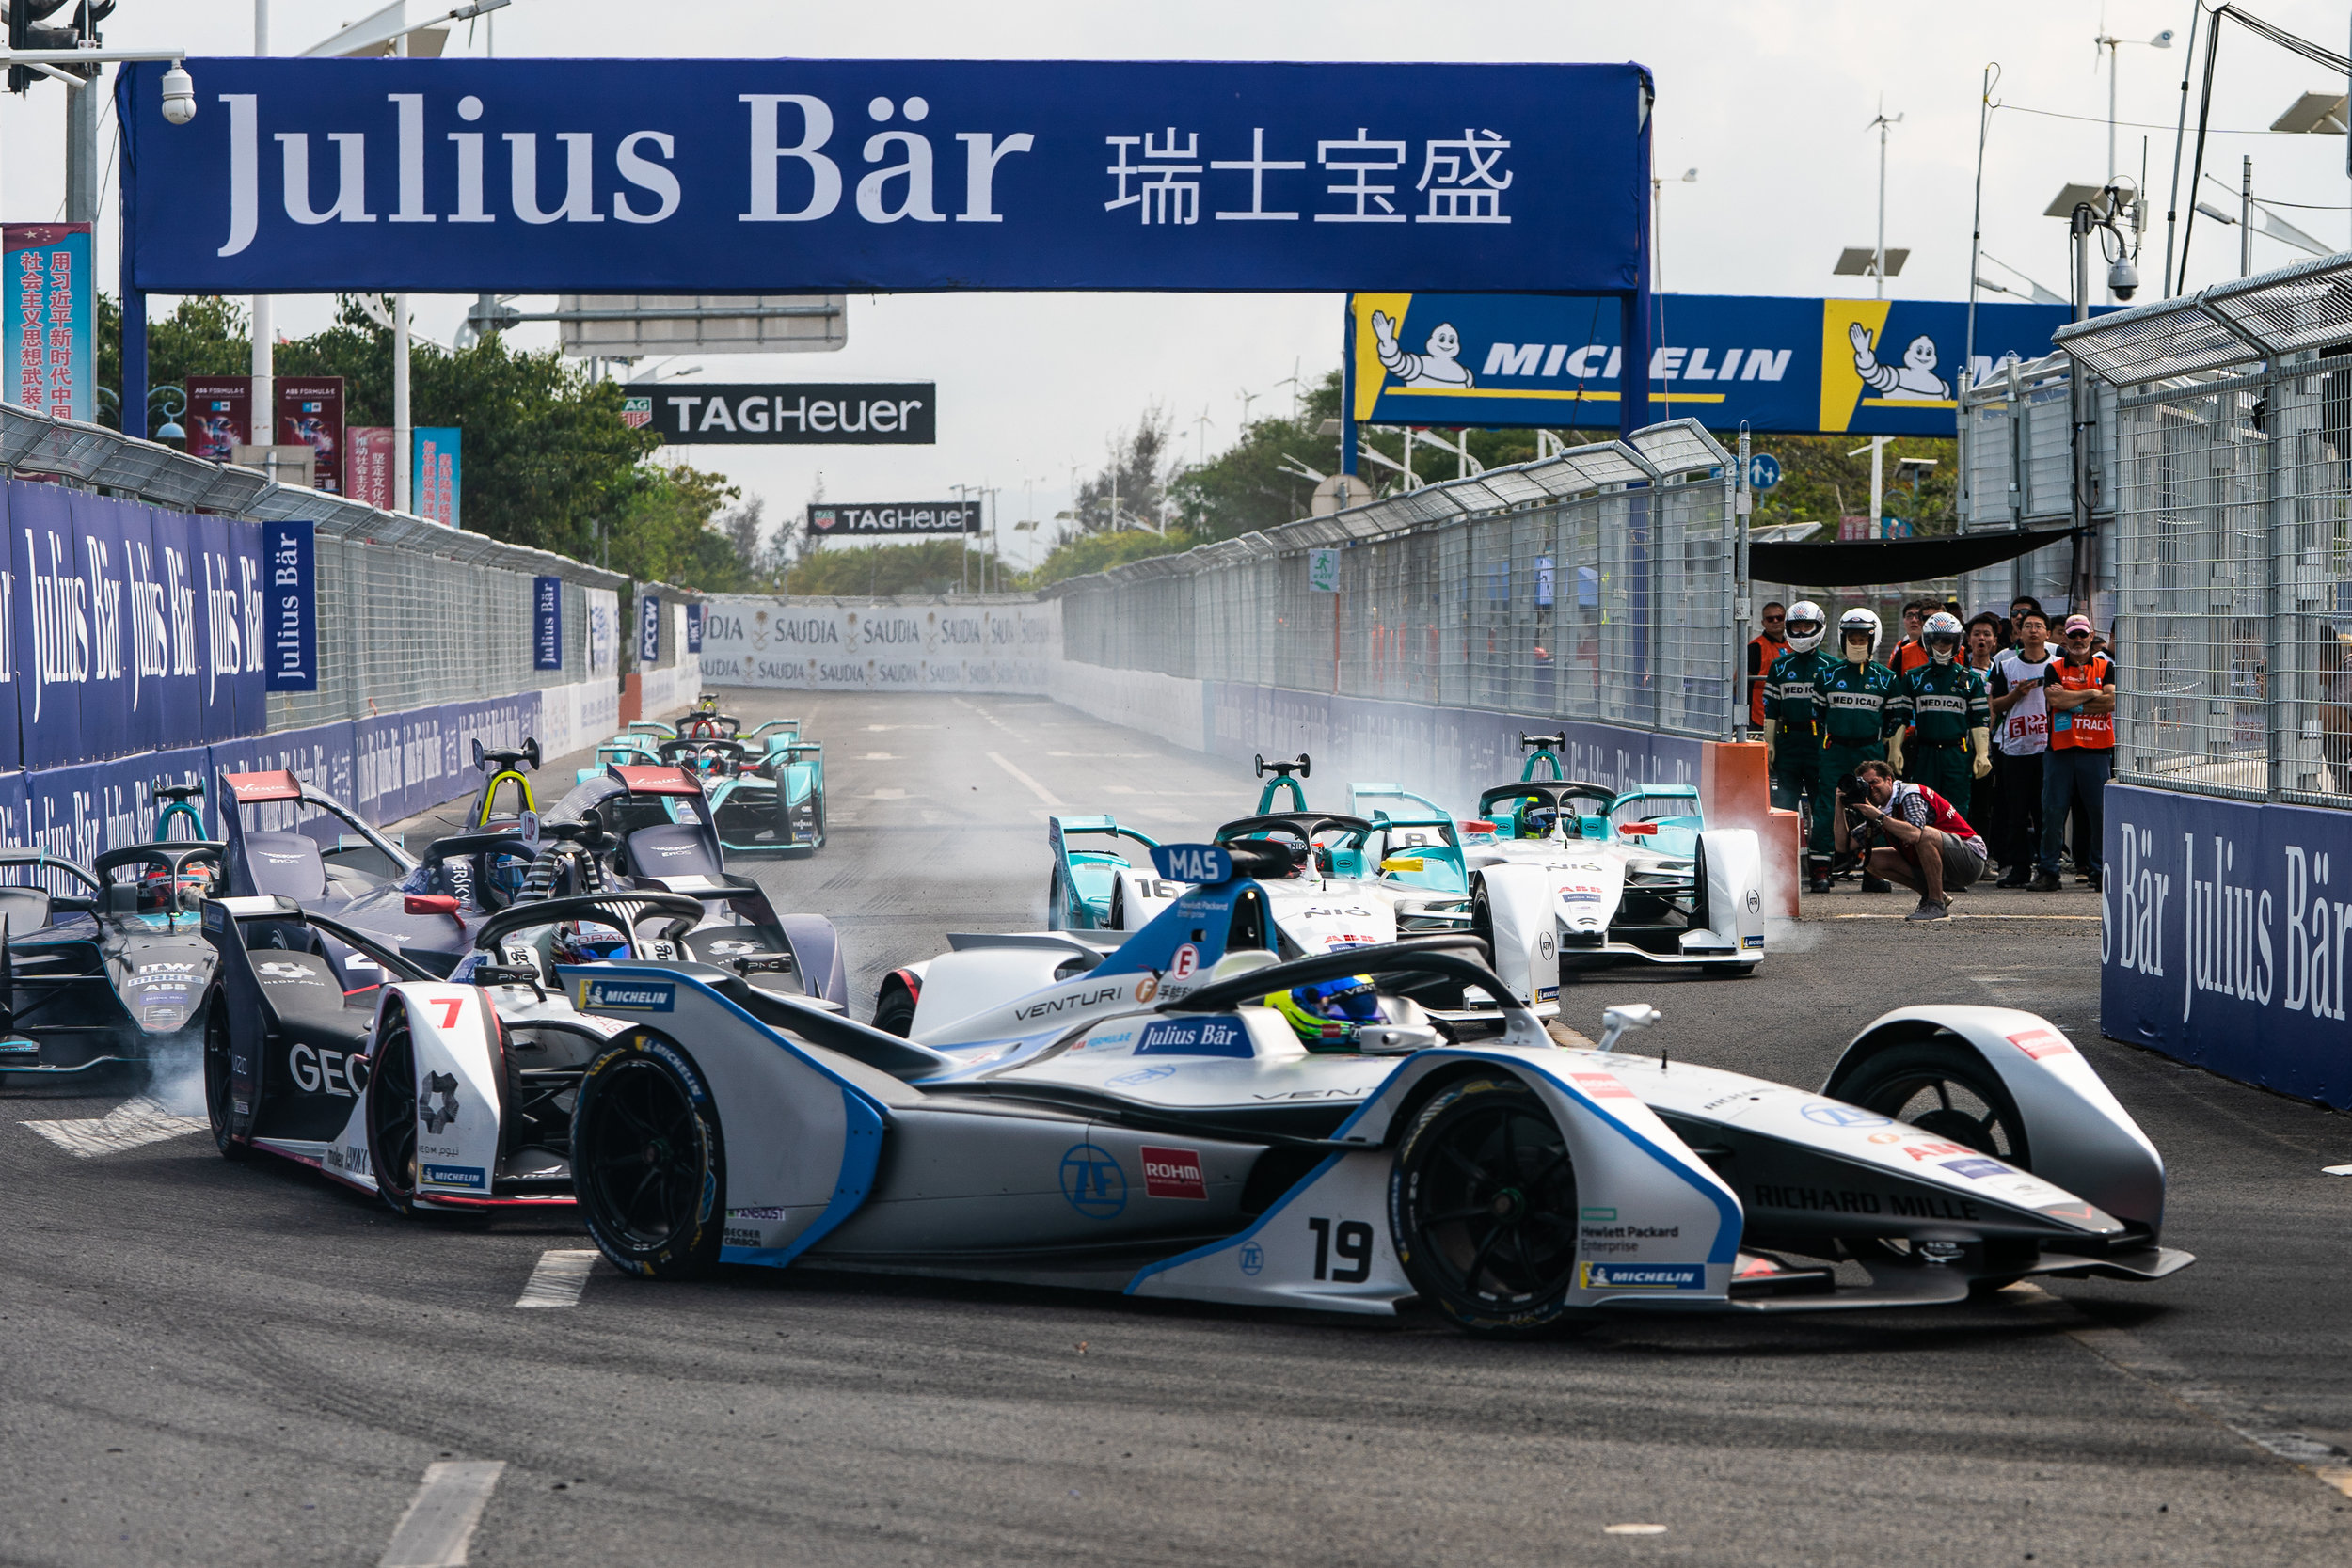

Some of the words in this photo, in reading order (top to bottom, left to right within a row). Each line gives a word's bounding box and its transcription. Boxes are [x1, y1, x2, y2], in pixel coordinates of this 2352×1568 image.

[217, 93, 682, 257] Julius
[739, 93, 1035, 224] Bär
[1104, 127, 1514, 225] 瑞士宝盛
[20, 251, 43, 412] 社会主义思想武装
[49, 251, 72, 420] 用习近平新时代中国
[624, 400, 649, 411] AG
[667, 395, 923, 433] TAGHeuer
[843, 508, 973, 529] TAGHeuer
[275, 532, 298, 587] Bär
[541, 582, 555, 612] Bär
[25, 528, 89, 723] Julius
[87, 534, 121, 680] Bär
[125, 539, 167, 712] Julius
[165, 546, 196, 676] Bär
[203, 551, 241, 707] Julius
[240, 556, 264, 673] Bär
[277, 595, 306, 679] Julius
[644, 599, 658, 659] PCCW
[689, 616, 701, 644] HKT
[774, 617, 839, 643] SAUDIA
[863, 618, 920, 644] SAUDIA
[540, 617, 558, 664] Julius
[758, 660, 804, 679] SAUDIA
[819, 663, 864, 682] SAUDIA
[2012, 724, 2023, 737] 6
[2074, 718, 2111, 731] TRACK
[1169, 848, 1219, 880] MAS
[1546, 863, 1603, 872] NIO
[1134, 879, 1179, 899] 16
[1304, 907, 1372, 919] NIO
[2120, 823, 2169, 976] Bär
[2184, 832, 2274, 1023] Julius
[2284, 845, 2352, 1021] Bär
[139, 962, 195, 975] ITW
[717, 956, 739, 965] NEO
[748, 961, 780, 970] PMC
[1177, 949, 1193, 976] E
[143, 983, 187, 992] ABB
[498, 973, 533, 981] PMC
[606, 990, 668, 1004] MICHELIN
[1014, 986, 1123, 1022] VENTURI
[429, 998, 463, 1029] 7
[1141, 1026, 1196, 1052] Julius
[1200, 1024, 1238, 1046] Bär
[289, 1043, 370, 1097] GEO
[653, 1042, 703, 1096] MICHELIN
[435, 1171, 480, 1182] MICHELIN
[1064, 1157, 1124, 1206] ZF
[1146, 1163, 1200, 1180] ROHM
[735, 1208, 786, 1220] FANBOOST
[1755, 1184, 1880, 1214] RICHARD
[1890, 1195, 1979, 1222] MILLE
[1581, 1225, 1626, 1238] Hewlett
[1628, 1225, 1679, 1238] Packard
[1309, 1217, 1374, 1284] 19
[1581, 1240, 1639, 1254] Enterprise
[1612, 1271, 1695, 1283] MICHELIN
